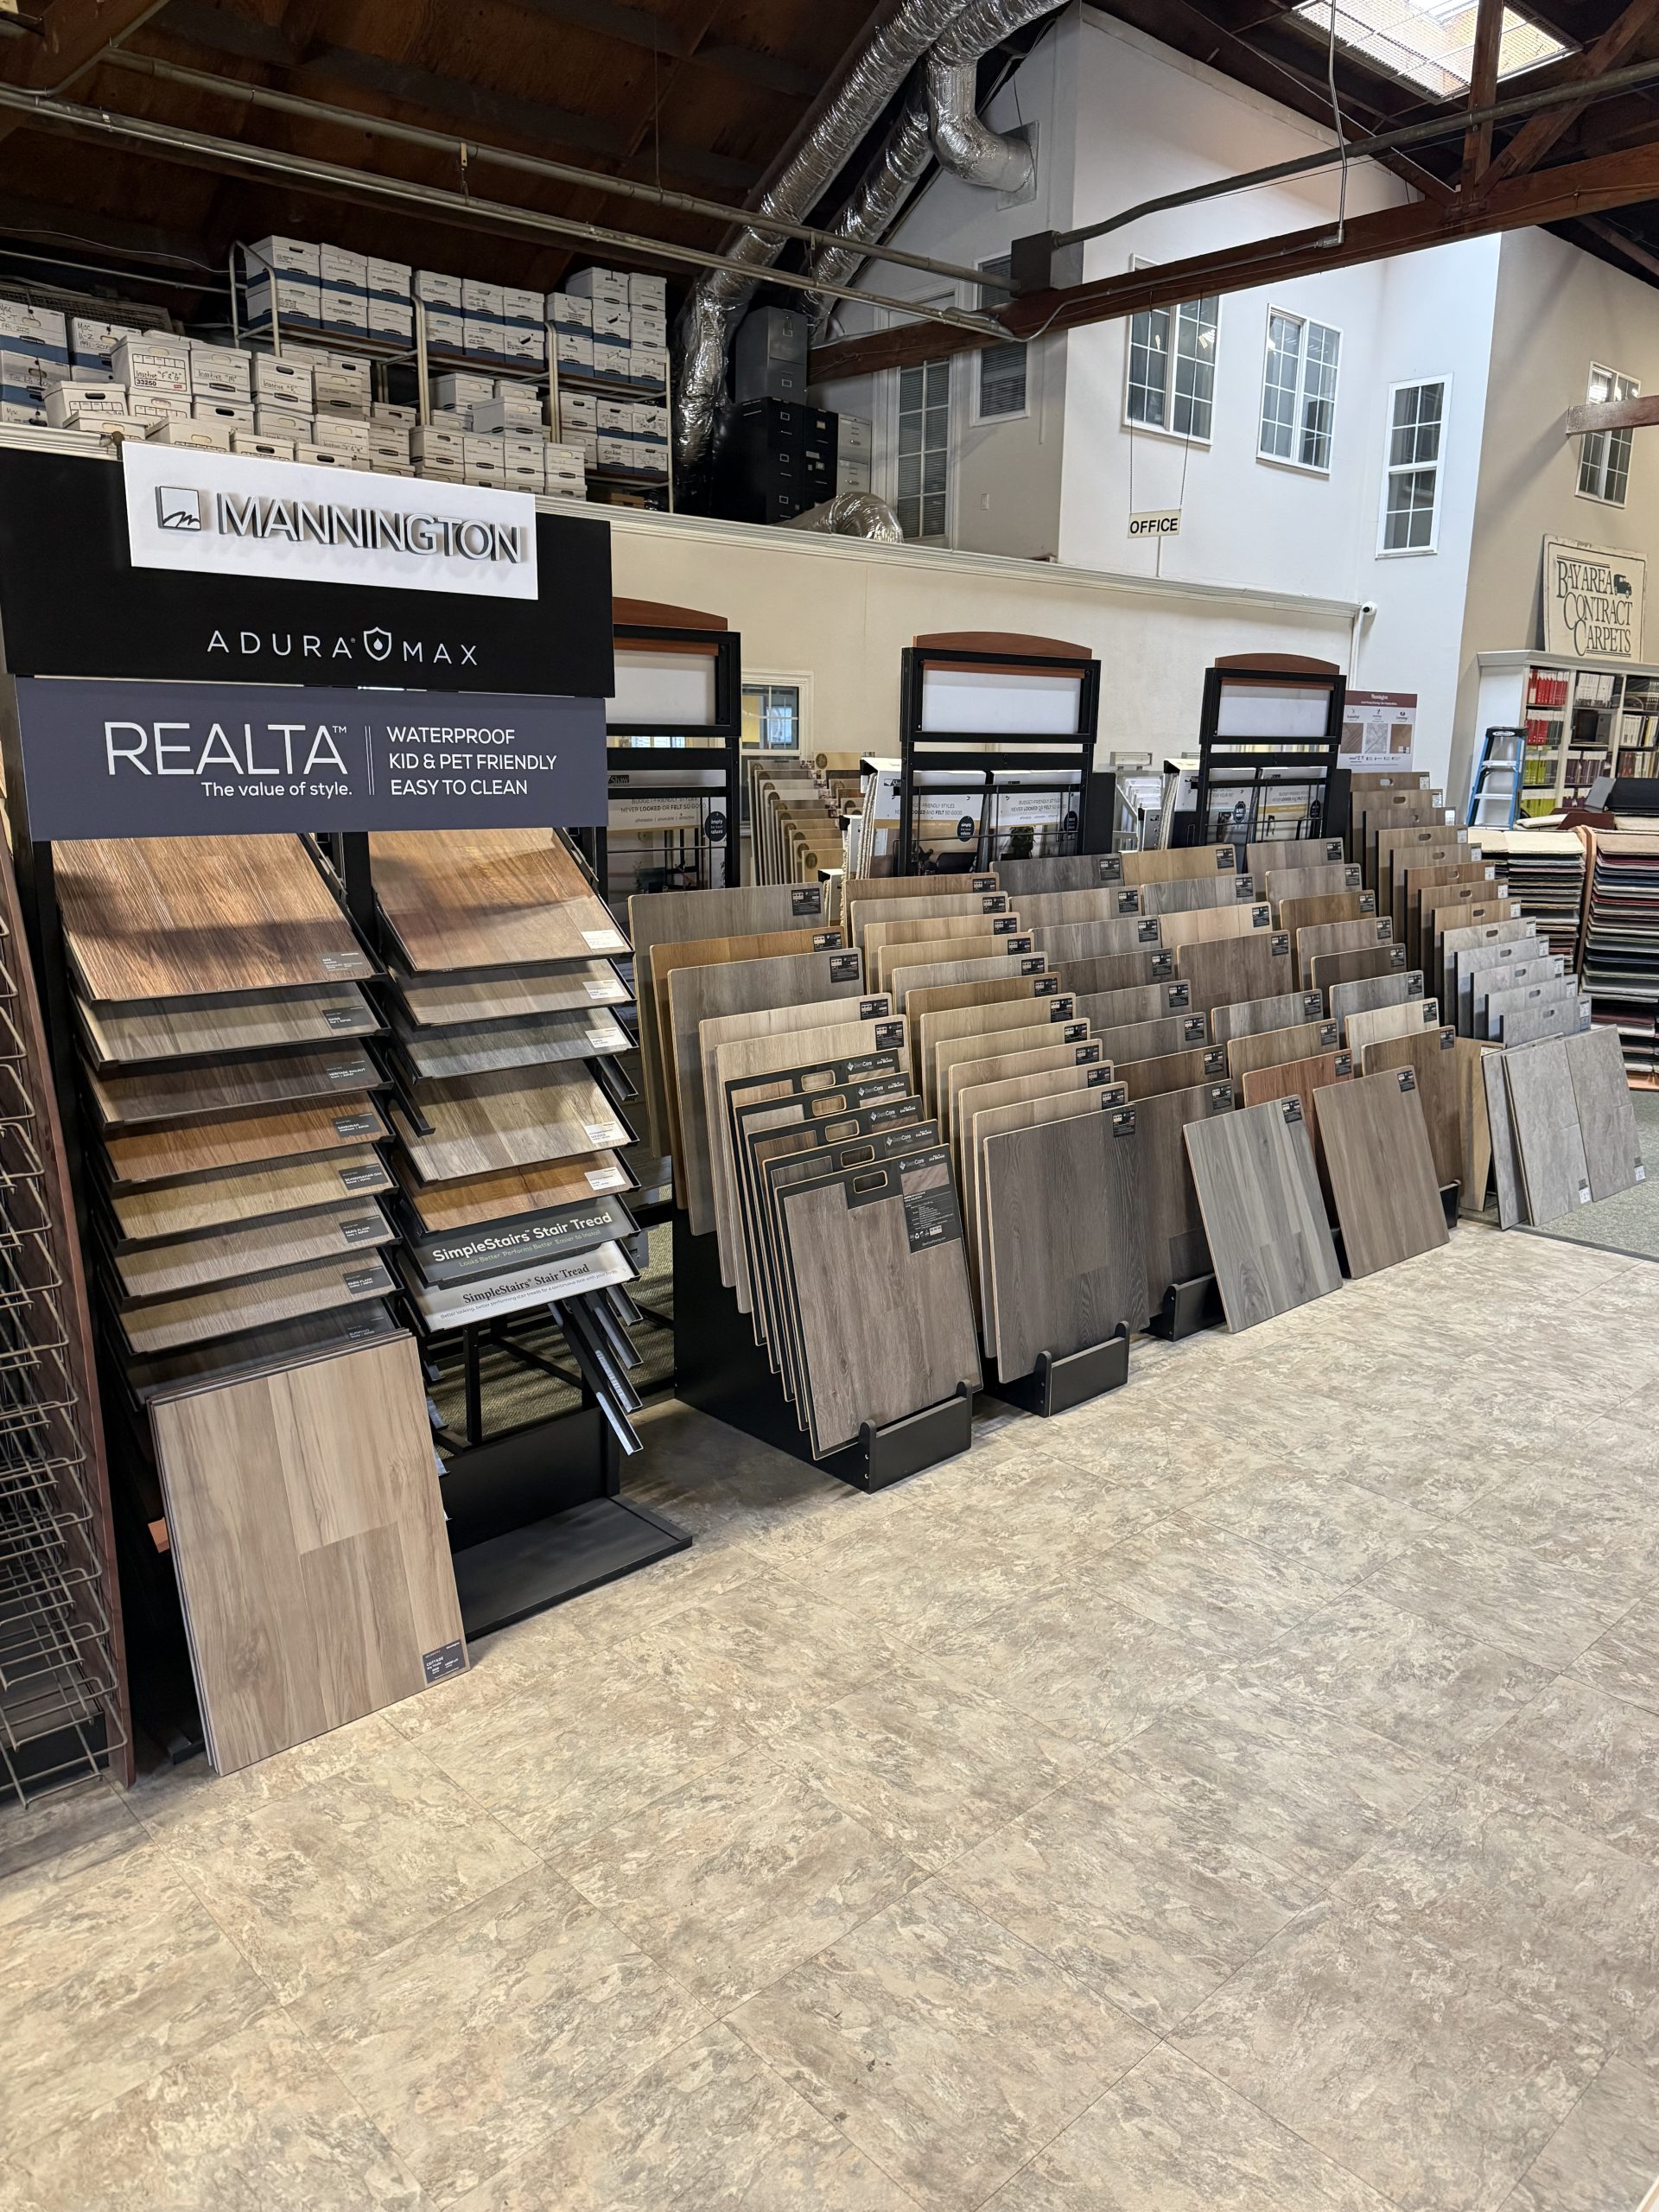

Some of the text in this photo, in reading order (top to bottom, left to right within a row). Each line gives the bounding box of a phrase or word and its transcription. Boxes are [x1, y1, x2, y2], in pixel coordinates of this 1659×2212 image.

[217, 493, 521, 563] MANNINGTON
[1129, 518, 1179, 534] OFFICE
[1556, 560, 1614, 599] BAY AREA
[1563, 592, 1633, 630] CONTRACT
[1573, 619, 1631, 657] CARPETS
[403, 640, 478, 665] MAX
[386, 726, 515, 745] WATERPROOF
[389, 753, 557, 770] KID & PET FRIENDLY
[200, 781, 353, 799] The value of style.
[391, 779, 528, 796] EASY TO CLEAN
[532, 1223, 569, 1239] Stair
[569, 1211, 613, 1230] Tread
[459, 1257, 479, 1268] Looks
[555, 1236, 574, 1245] Easier
[582, 1229, 601, 1238] Install
[534, 1272, 559, 1286] Stair
[559, 1263, 590, 1279] Tread
[440, 1311, 456, 1319] Better
[475, 1301, 490, 1311] better
